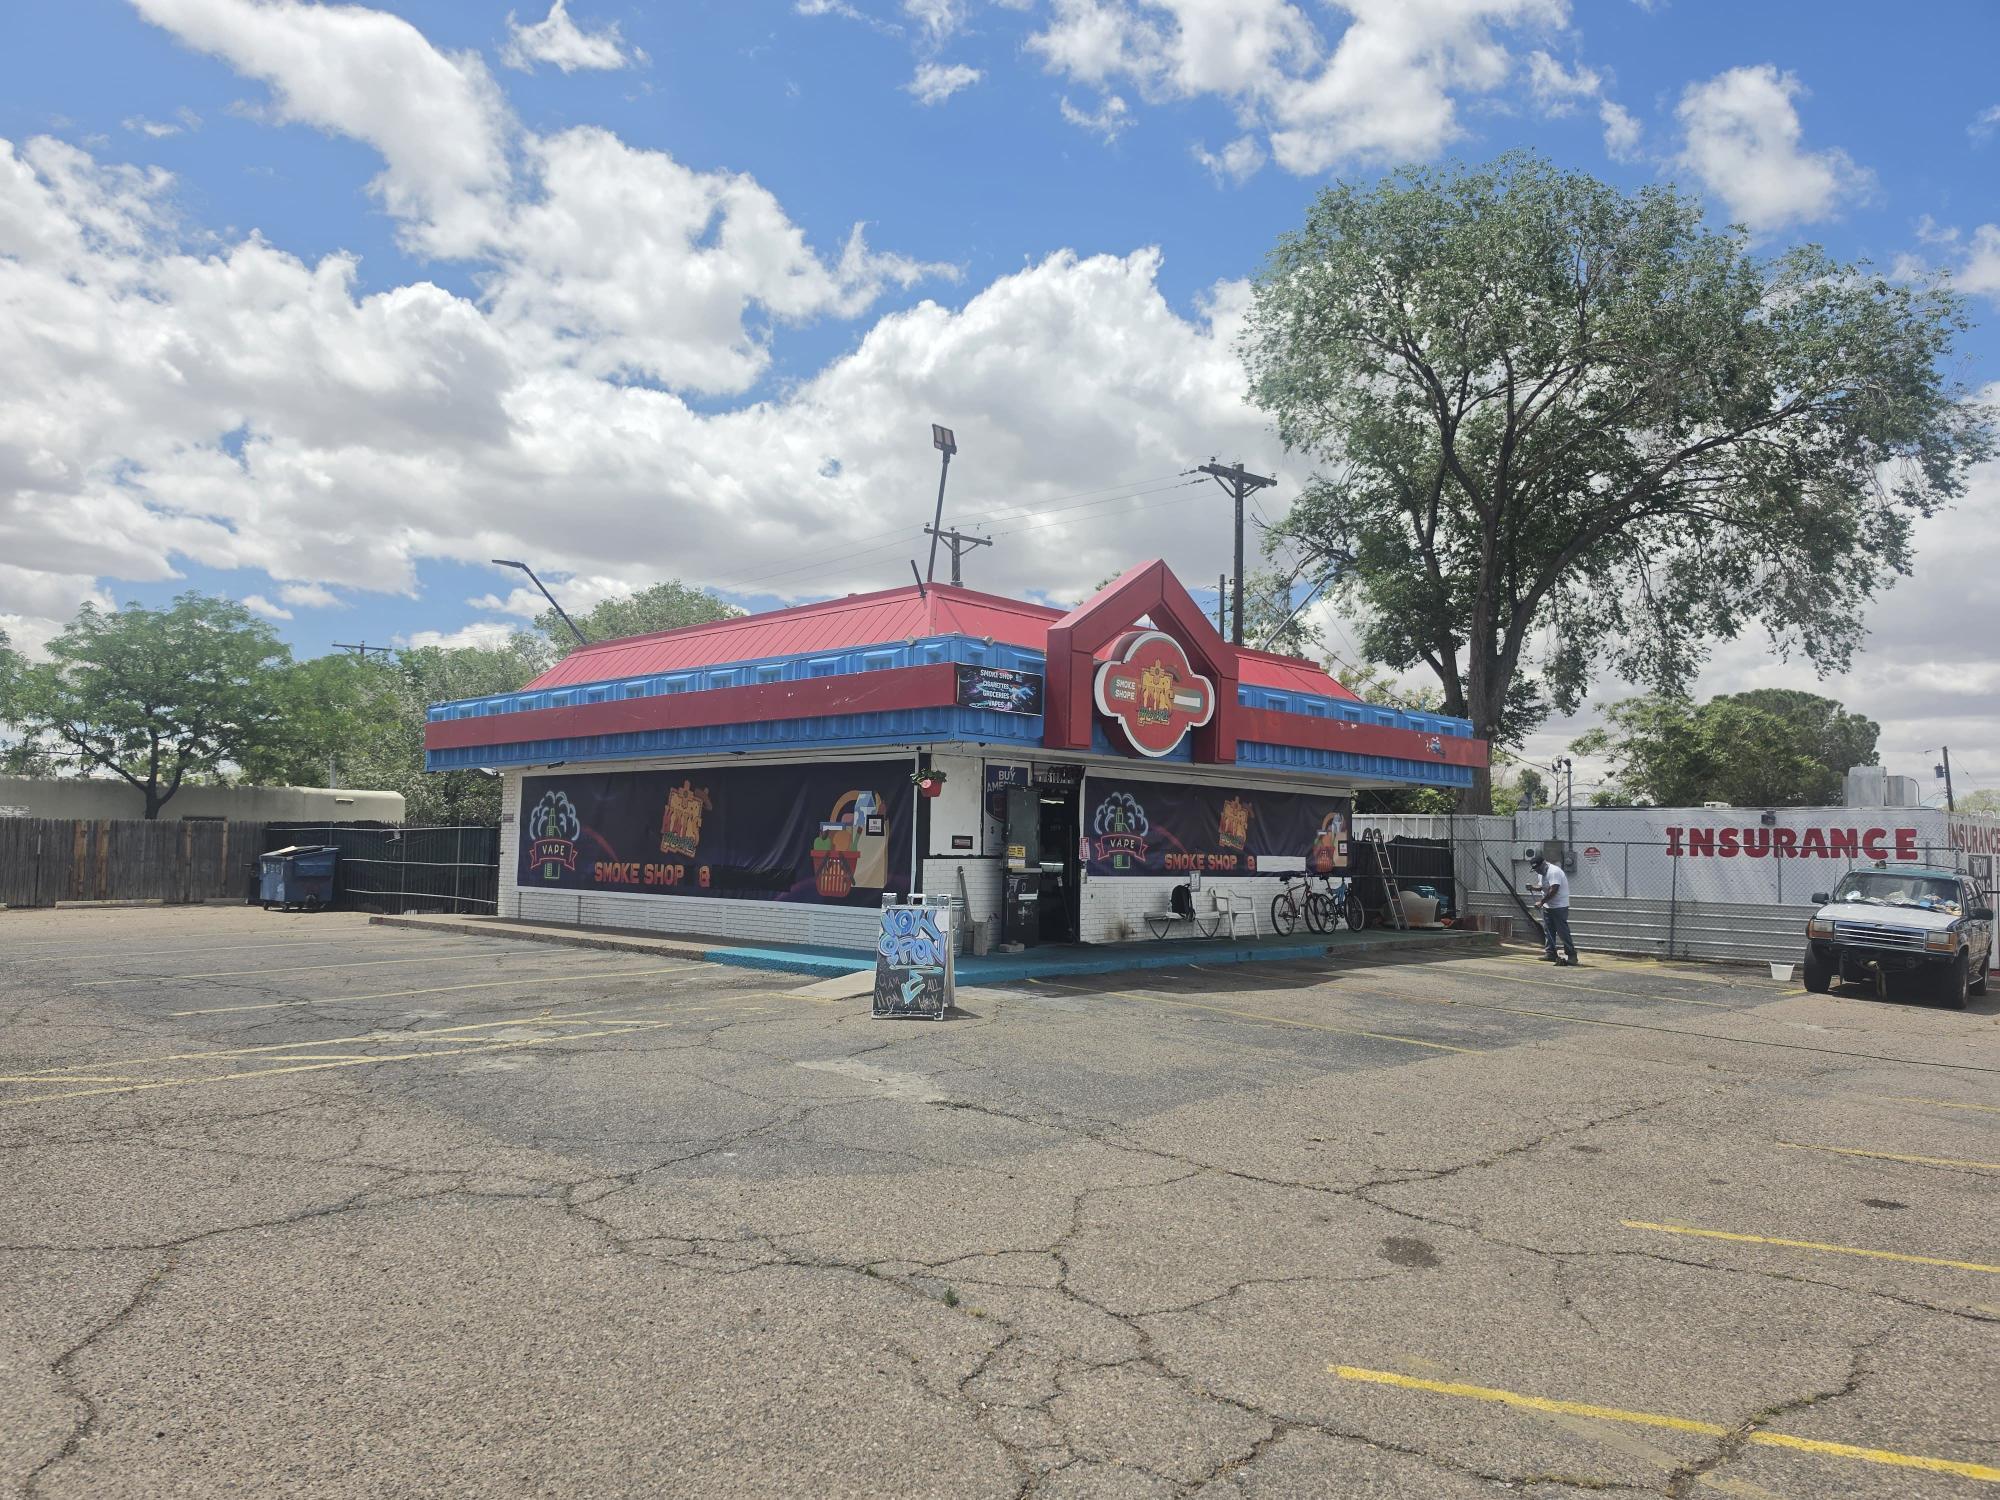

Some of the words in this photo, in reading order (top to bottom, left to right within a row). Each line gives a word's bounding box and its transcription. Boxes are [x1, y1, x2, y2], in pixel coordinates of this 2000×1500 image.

[980, 669, 998, 678] SMOKE
[999, 672, 1013, 681] SHOP
[982, 680, 1009, 690] CIGARETTES
[1116, 679, 1136, 690] SMOKE
[982, 689, 1009, 700] GROCERIES
[1114, 689, 1136, 701] SHOPE
[988, 699, 1005, 709] VAPES
[998, 770, 1016, 781] BUY
[542, 844, 565, 856] VAPE
[1110, 839, 1136, 849] VAPE
[1665, 827, 1919, 861] INSURANCE
[1164, 853, 1205, 871] SMOKE
[1207, 854, 1237, 871] SHOP
[594, 861, 640, 884] SMOKE
[643, 863, 685, 886] SHOP
[880, 909, 942, 941] NOW
[878, 931, 948, 967] OPEN
[926, 977, 942, 993] ALL
